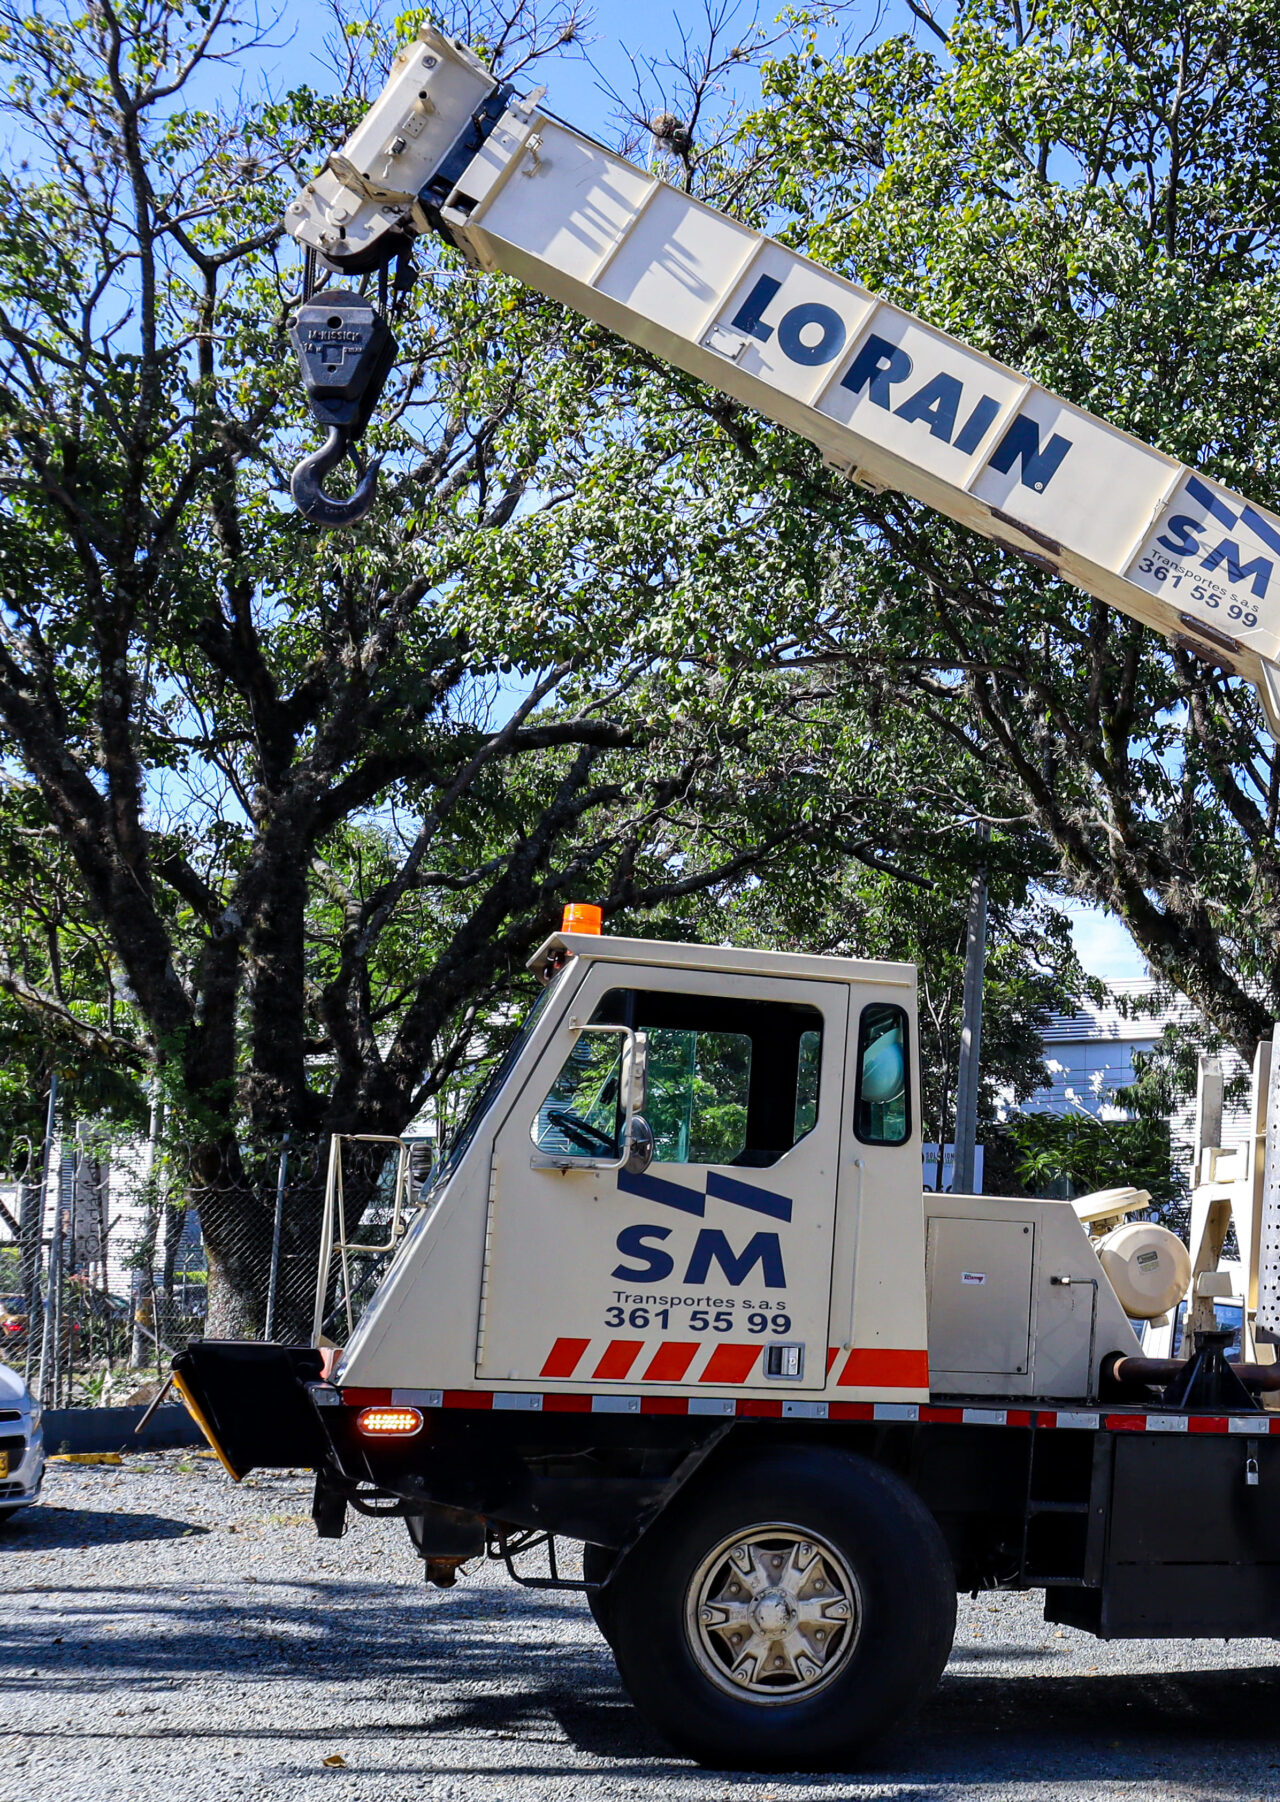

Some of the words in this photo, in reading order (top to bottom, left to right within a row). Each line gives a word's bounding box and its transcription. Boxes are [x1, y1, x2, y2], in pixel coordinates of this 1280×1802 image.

[731, 273, 1073, 495] LORAIN
[1151, 549, 1227, 596] Transportes
[1156, 514, 1274, 600] SM
[1138, 558, 1182, 589] 361
[1190, 585, 1222, 609] 55
[1227, 604, 1258, 628] 99
[610, 1223, 787, 1289] SM
[604, 1306, 669, 1330] 361
[688, 1310, 734, 1333] 55
[747, 1313, 792, 1335] 99
[612, 1290, 735, 1309] Transportes
[742, 1299, 787, 1311] s.a.s
